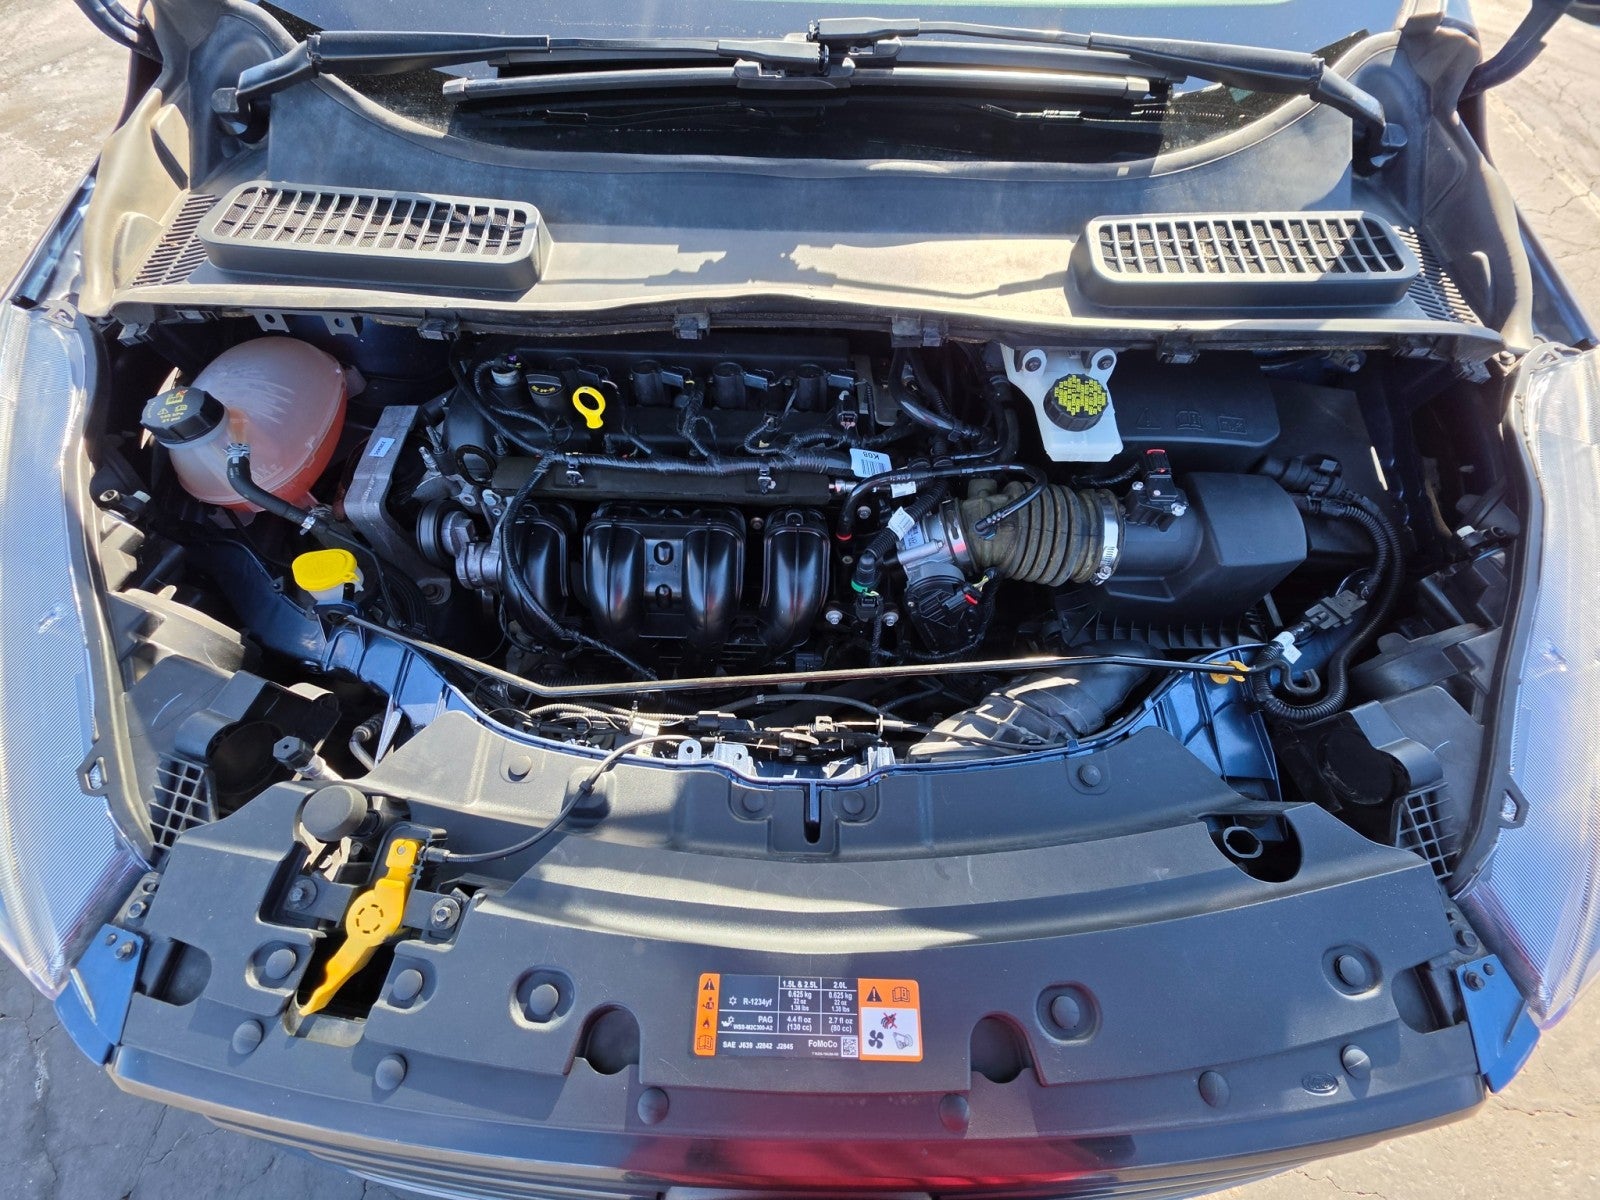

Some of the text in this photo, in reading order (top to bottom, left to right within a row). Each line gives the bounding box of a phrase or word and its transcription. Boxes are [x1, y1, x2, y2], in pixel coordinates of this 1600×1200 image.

[782, 980, 796, 988] 1.5L
[797, 980, 803, 988] &
[833, 981, 847, 989] 2.0L
[804, 991, 812, 1000] kg
[845, 992, 853, 1001] kg
[743, 998, 773, 1007] R-1234yf
[758, 1015, 773, 1024] PAG
[787, 1023, 812, 1032] (130 cc)
[830, 1024, 852, 1033] (80 cc)
[808, 1039, 838, 1048] FoMoCo
